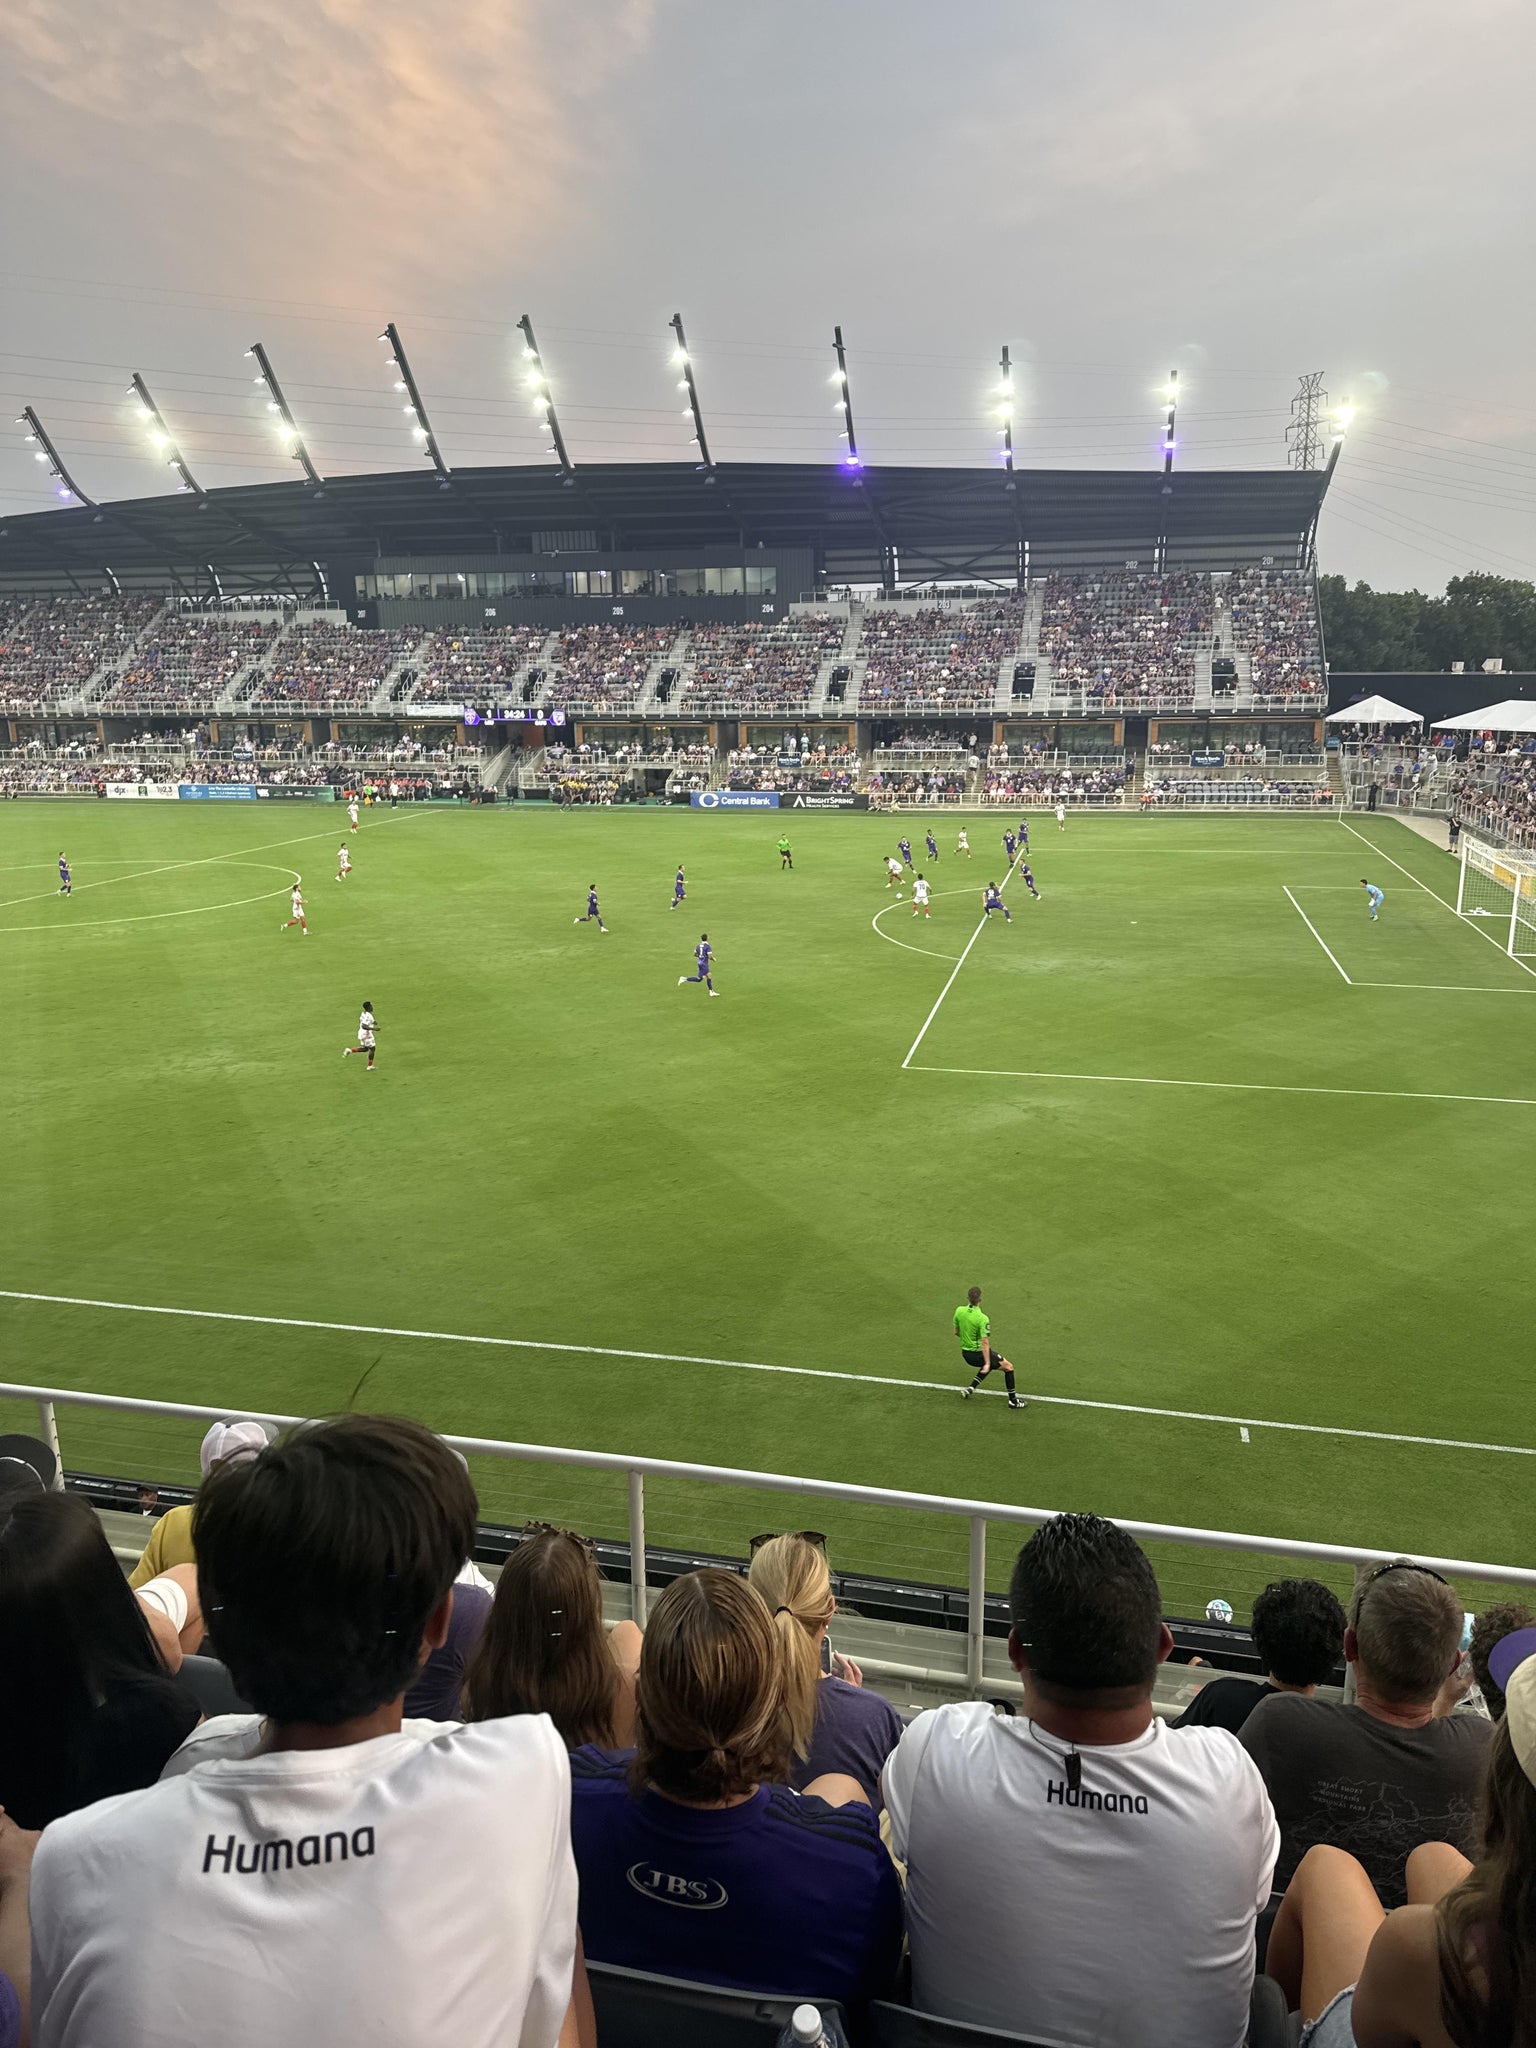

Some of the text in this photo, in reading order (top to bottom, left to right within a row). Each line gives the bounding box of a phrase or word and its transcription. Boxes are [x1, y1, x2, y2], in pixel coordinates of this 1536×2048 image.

[1125, 561, 1138, 569] 202
[485, 608, 496, 616] 206
[613, 607, 624, 615] 205
[762, 604, 774, 613] 204
[486, 709, 544, 719] 1 34:24 0
[721, 797, 771, 806] Central Bank
[1047, 1779, 1149, 1815] Humana
[202, 1826, 375, 1874] Humana
[643, 1869, 708, 1900] JBS
